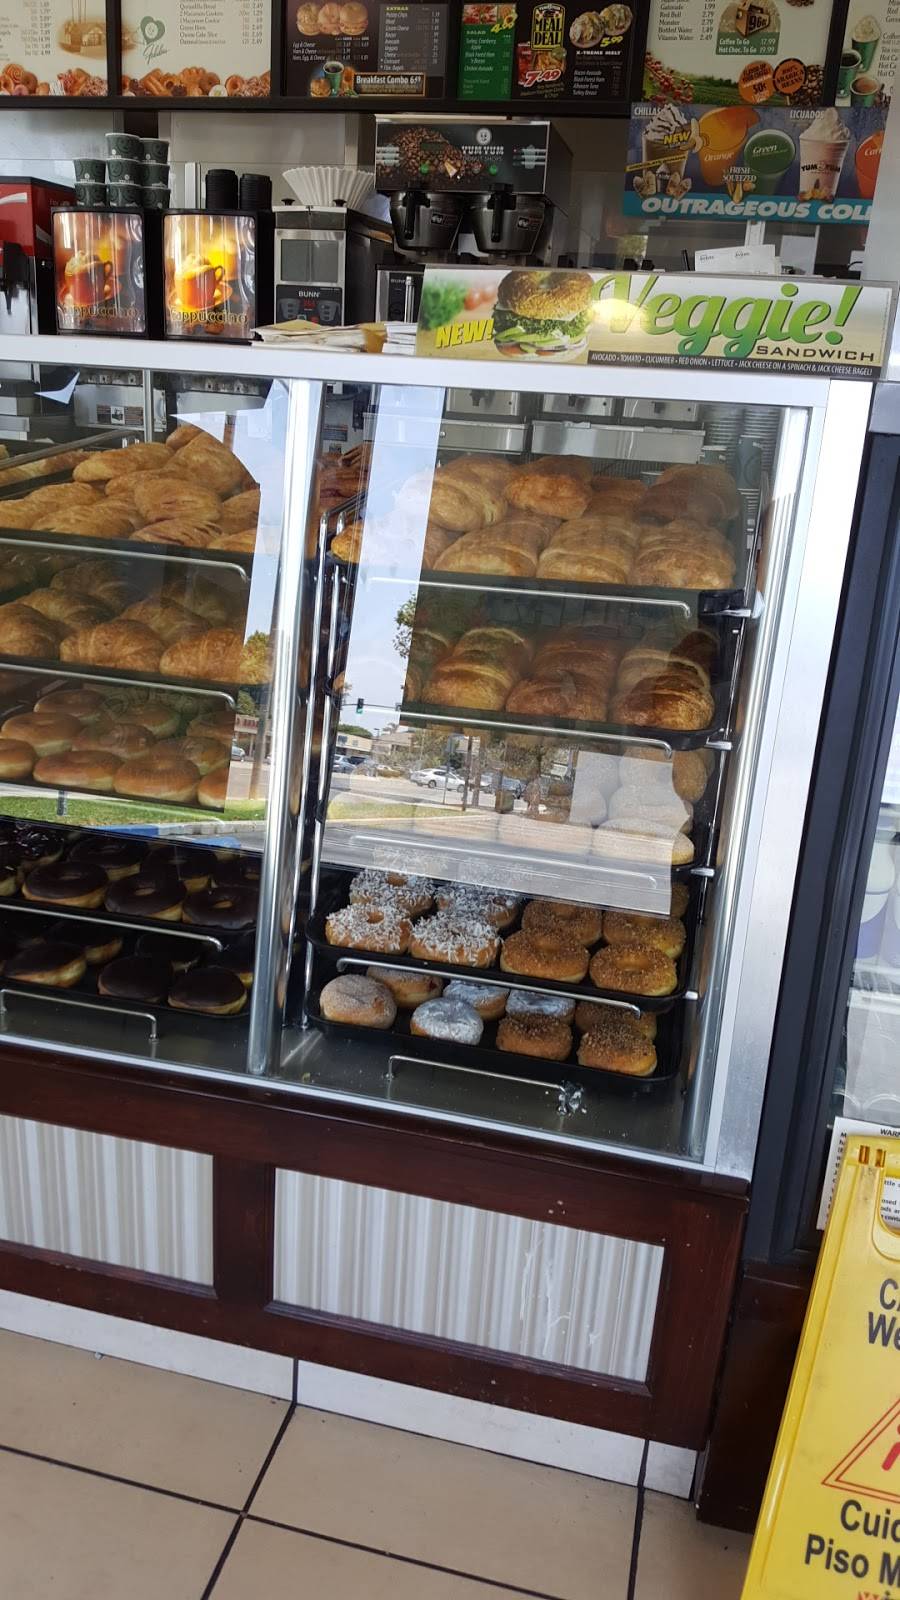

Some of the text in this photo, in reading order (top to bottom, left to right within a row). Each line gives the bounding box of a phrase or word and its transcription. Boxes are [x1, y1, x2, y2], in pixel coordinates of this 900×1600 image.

[533, 31, 563, 47] DEAL
[356, 75, 386, 84] Breakfast
[387, 75, 409, 84] Combo
[523, 69, 562, 88] 7.49
[663, 130, 691, 146] NEW
[461, 146, 504, 156] YUM YUM
[703, 151, 735, 163] Orange
[752, 143, 778, 155] Green
[729, 166, 751, 175] FRESH
[801, 164, 818, 172] YUM
[722, 173, 758, 183] SQUEEZED
[641, 198, 811, 219] OUTRAGEOUS
[298, 290, 320, 298] BUNN
[591, 274, 863, 359] Veggie!
[436, 319, 494, 348] NEW!
[756, 345, 875, 362] SANDWICH
[591, 353, 617, 361] AVOCADO
[620, 354, 642, 362] TOMATO
[645, 356, 675, 364] CUCUMBER
[678, 357, 690, 365] RED
[690, 358, 708, 366] ONION
[711, 358, 735, 368] LETTUCE
[738, 360, 752, 369] JACK
[752, 360, 773, 369] CHEESE
[772, 361, 781, 370] ON
[787, 362, 811, 371] SPINACH
[817, 364, 831, 373] JACK
[830, 365, 851, 375] CHEESE
[852, 366, 873, 376] BAGEL!
[804, 1533, 870, 1579] Piso
